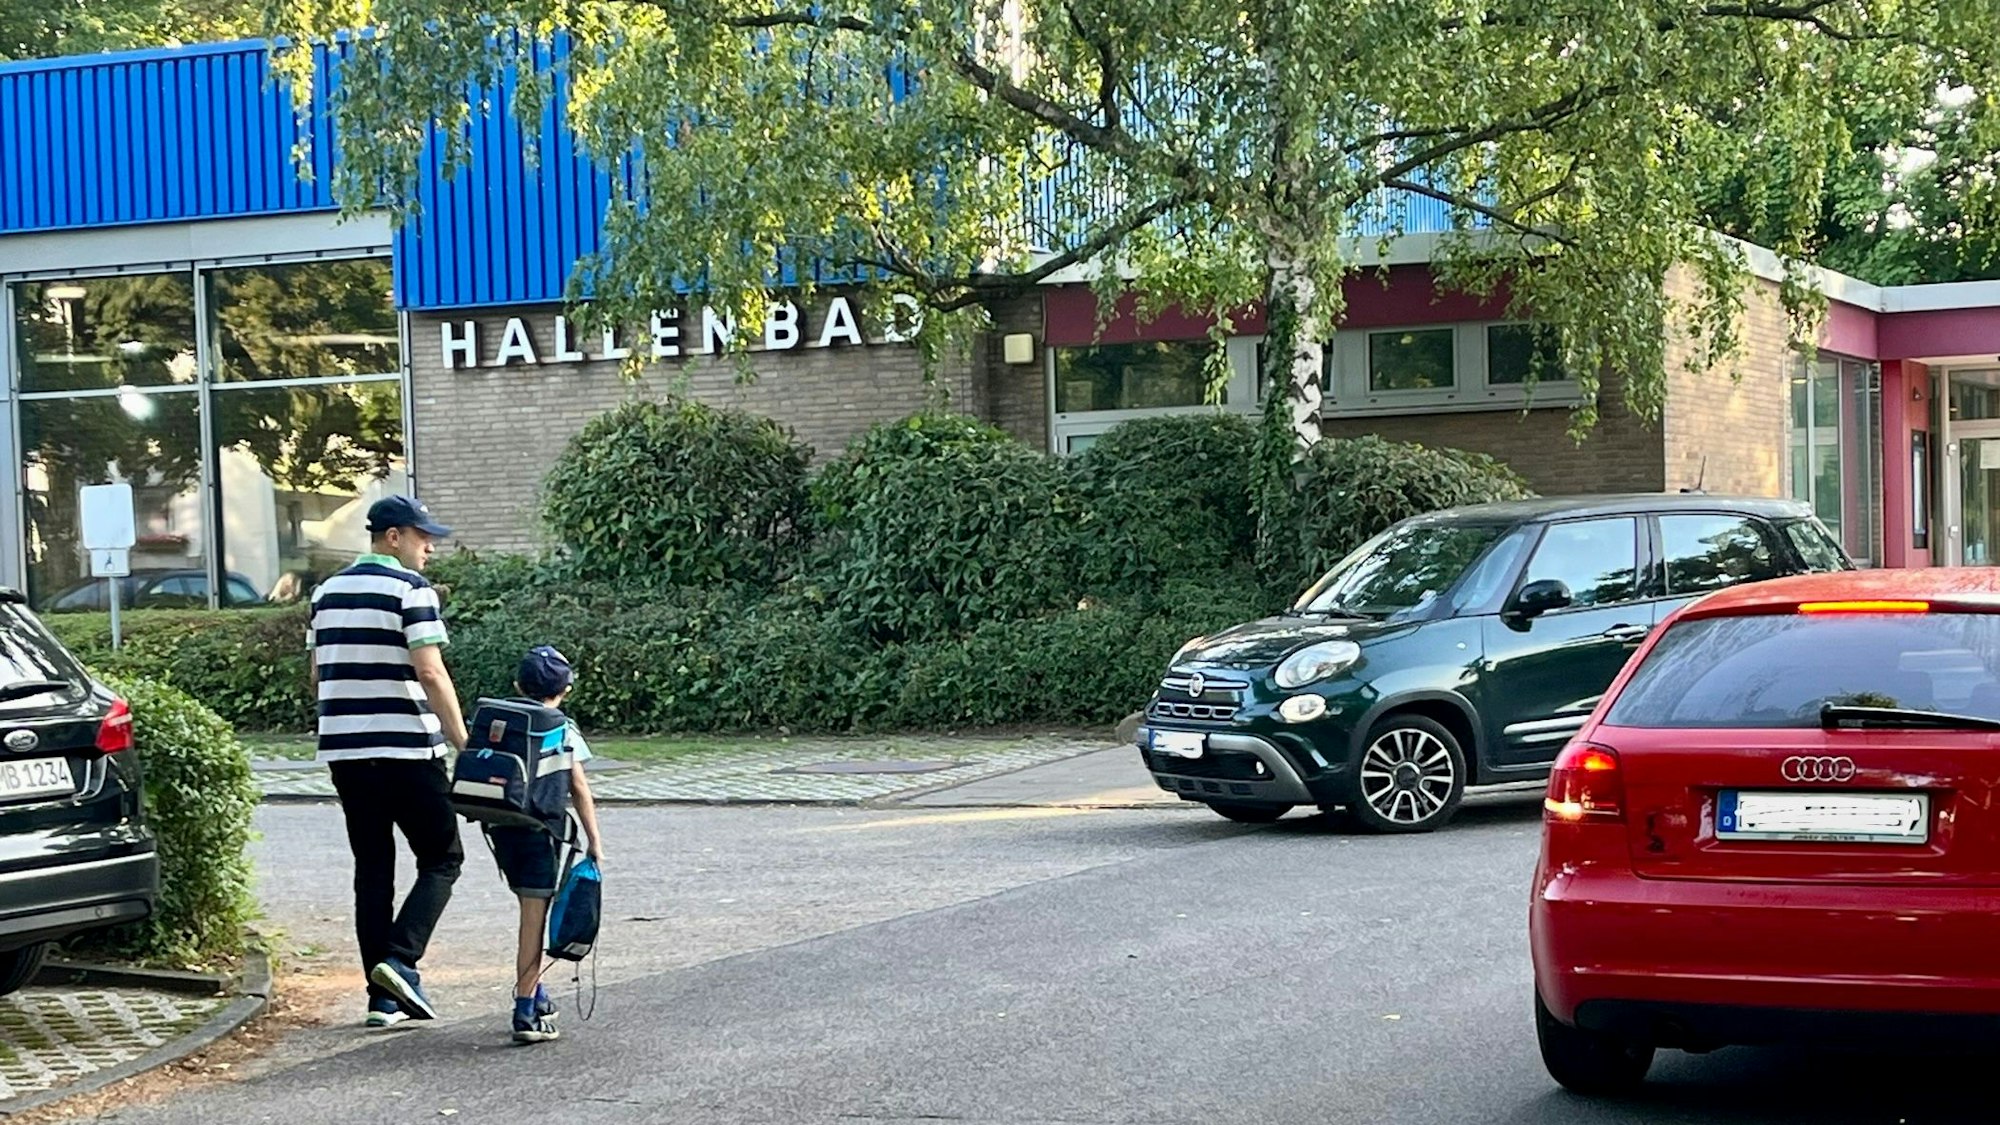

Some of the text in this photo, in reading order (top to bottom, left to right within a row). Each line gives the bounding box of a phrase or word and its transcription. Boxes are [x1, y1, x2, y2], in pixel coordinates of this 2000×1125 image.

[441, 293, 924, 369] HALLENBAD
[22, 761, 69, 787] 1234
[1723, 815, 1732, 826] D
